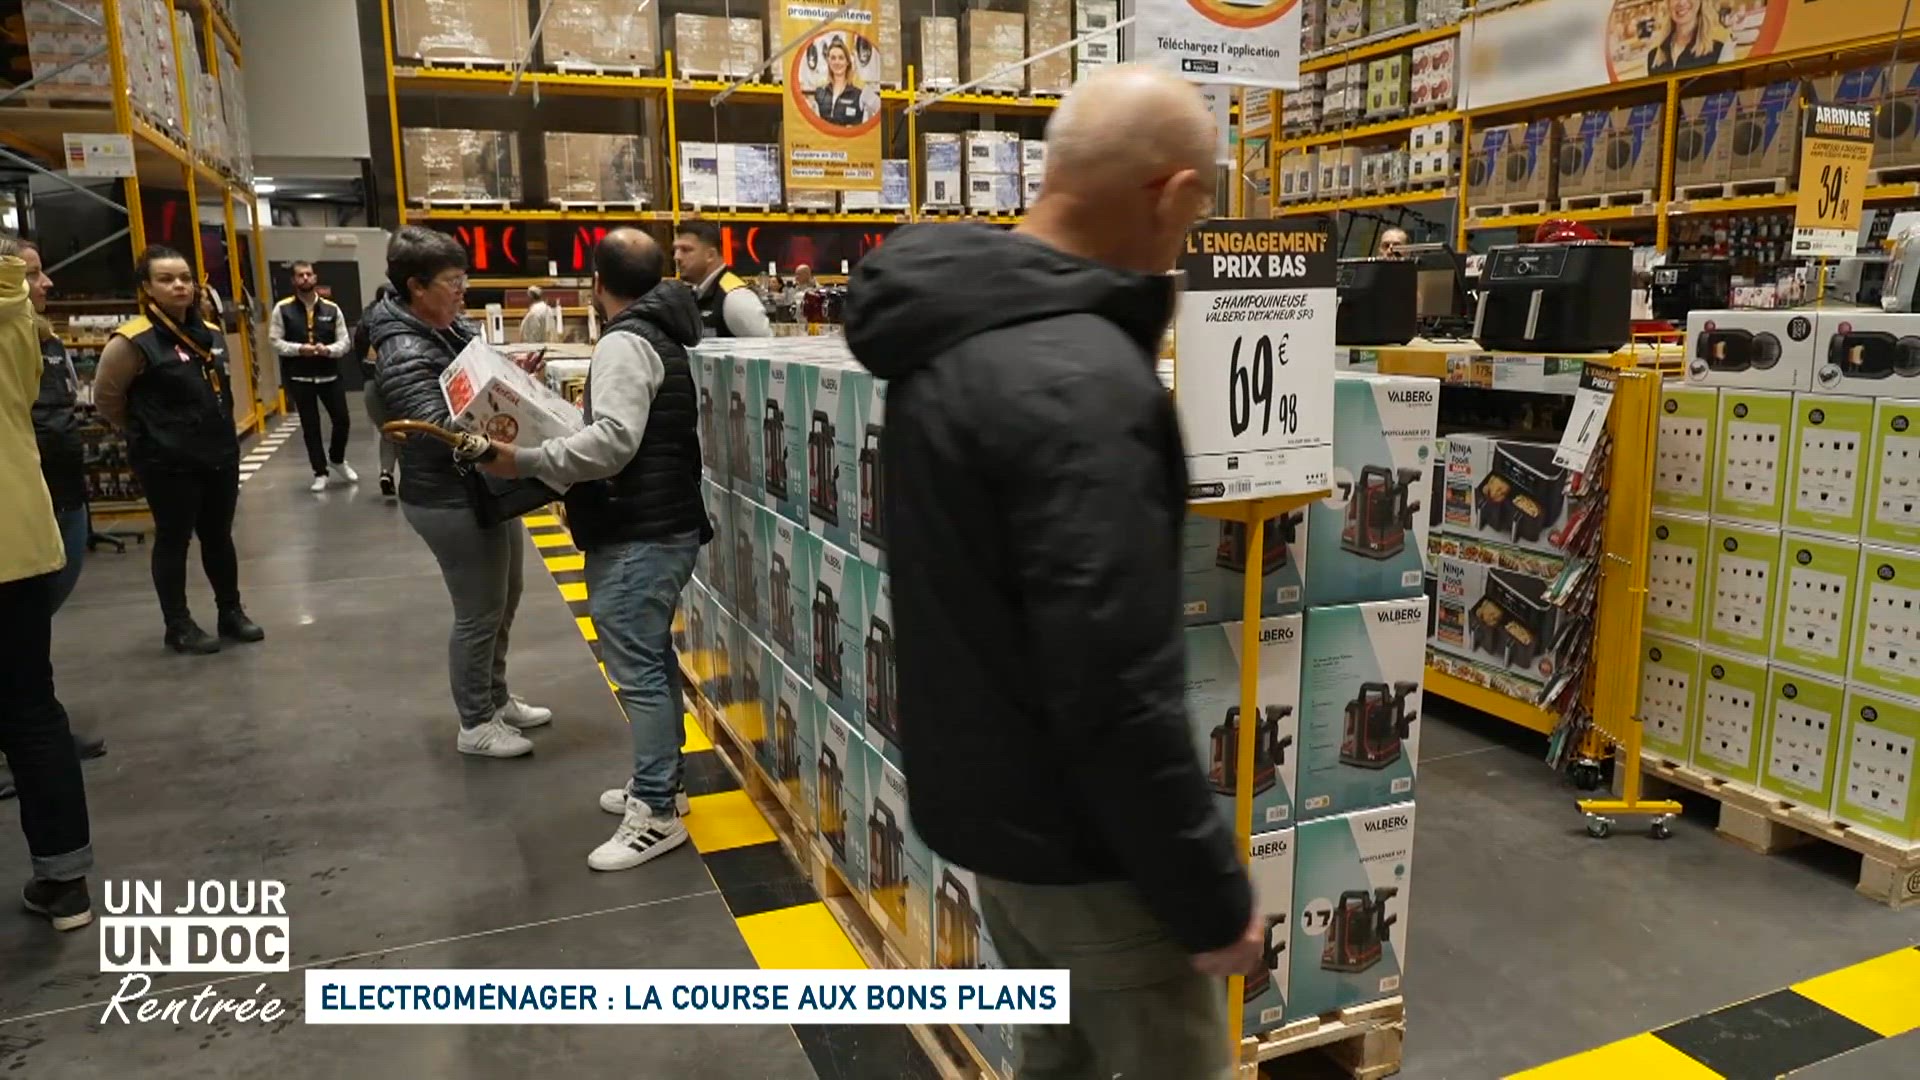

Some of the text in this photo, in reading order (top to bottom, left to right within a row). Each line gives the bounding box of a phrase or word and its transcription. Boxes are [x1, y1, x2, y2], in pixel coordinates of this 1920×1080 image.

[788, 7, 872, 21] promotio nterne
[1157, 37, 1281, 59] Téléchargez l'application
[1815, 106, 1871, 129] ARRIVAGE
[1818, 164, 1842, 220] 39
[1186, 231, 1329, 254] L'ENGAGEMENT
[1213, 253, 1308, 279] PRIX BAS
[1212, 293, 1308, 311] SHAMPOUINEUSE
[1205, 308, 1314, 323] VALBERG DETACHEUR SP3
[1229, 333, 1298, 438] 69 € 98
[1387, 390, 1433, 403] VALBERG
[1450, 441, 1472, 456] NINJA
[1443, 562, 1465, 578] NINJA
[1377, 608, 1422, 624] VALBERG
[1258, 628, 1295, 643] LBERG
[1364, 816, 1409, 834] VALBERG
